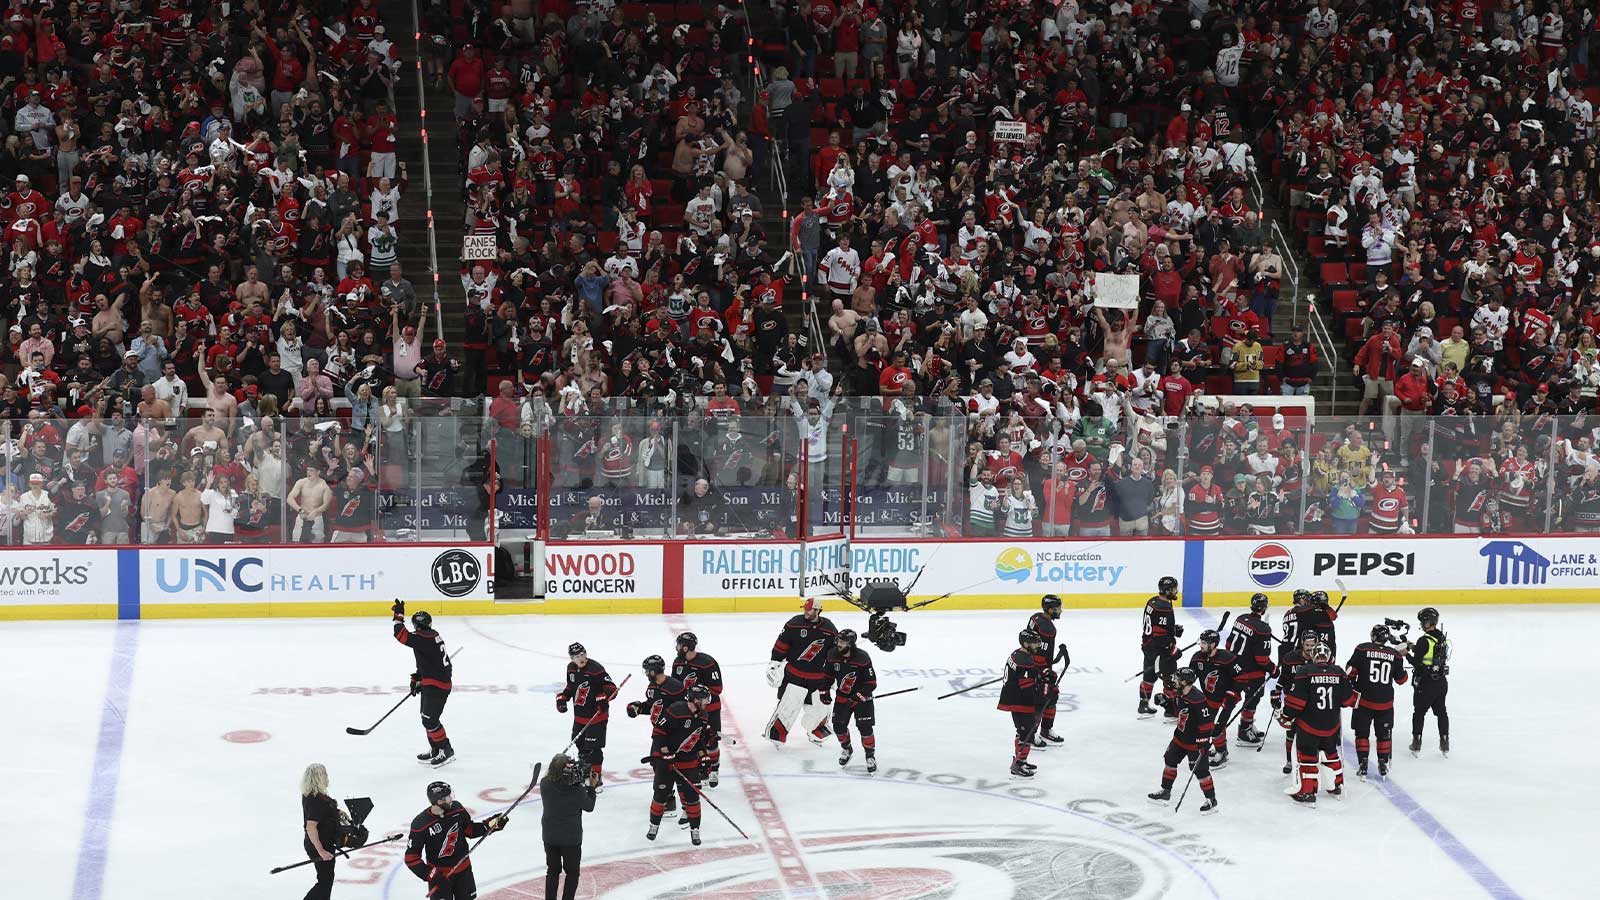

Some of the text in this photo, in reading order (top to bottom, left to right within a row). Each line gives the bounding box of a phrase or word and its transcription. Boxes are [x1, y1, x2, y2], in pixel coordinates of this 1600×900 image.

[1226, 60, 1236, 75] 12
[1215, 119, 1230, 135] 12
[464, 236, 496, 247] CANES
[468, 248, 494, 258] ROCK
[897, 432, 914, 450] 53
[723, 492, 748, 505] Son
[702, 549, 783, 575] RALEIGH
[1036, 552, 1101, 562] NC Education
[1313, 552, 1415, 576] PEPSI
[1553, 553, 1597, 565] LANE &
[1251, 560, 1290, 571] PEPSI
[1551, 567, 1599, 577] OFFICIAL
[156, 557, 375, 593] UNC HEALTH
[435, 560, 477, 586] LBC
[1035, 562, 1124, 587] Lottery
[563, 578, 635, 593] CONCERN
[722, 577, 784, 591] OFFICIAL
[16, 588, 35, 596] with
[37, 588, 60, 596] Pride
[1230, 630, 1247, 655] 77
[1320, 632, 1329, 641] 24
[1263, 640, 1271, 649] 77
[1366, 650, 1395, 661] ROBINSON
[1369, 660, 1392, 684] 50
[1311, 675, 1340, 684] ANDERSEN
[1316, 686, 1333, 710] 31
